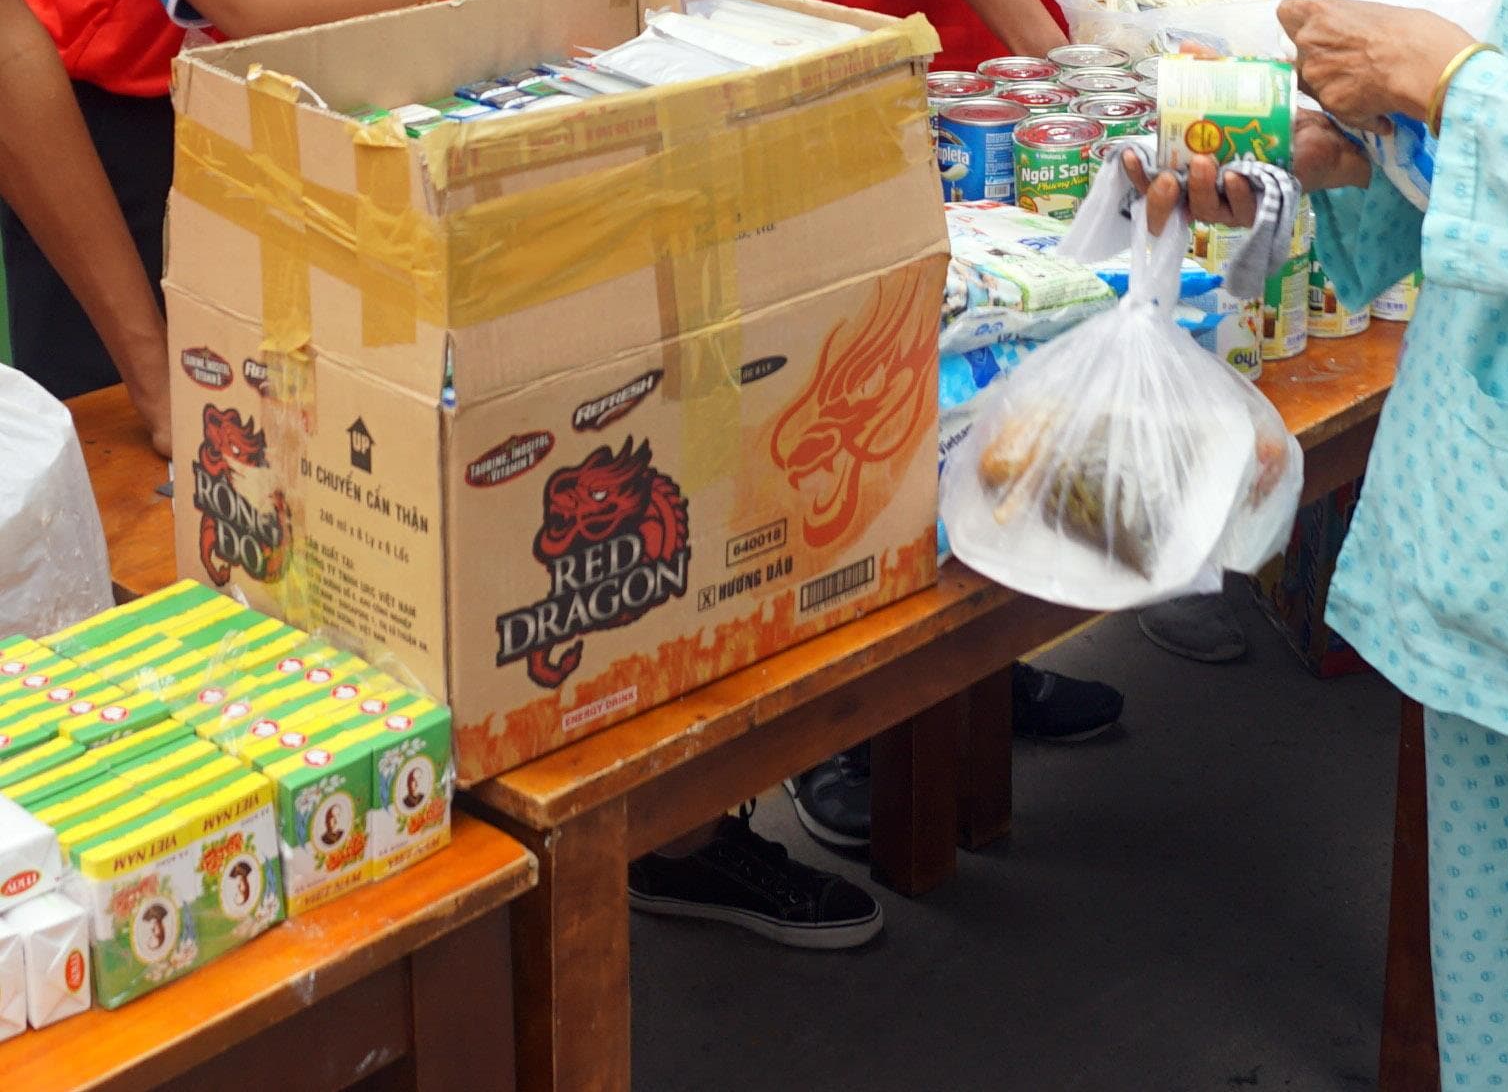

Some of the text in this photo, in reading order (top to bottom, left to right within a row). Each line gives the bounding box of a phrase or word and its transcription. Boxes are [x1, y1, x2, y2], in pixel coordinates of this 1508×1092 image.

[937, 145, 970, 165] pleta
[1021, 163, 1089, 185] Ngôi Sao
[574, 374, 655, 426] REFRESH
[351, 431, 370, 455] UP
[301, 458, 312, 478] DI
[551, 532, 643, 598] RED
[498, 551, 689, 660] DRAGON
